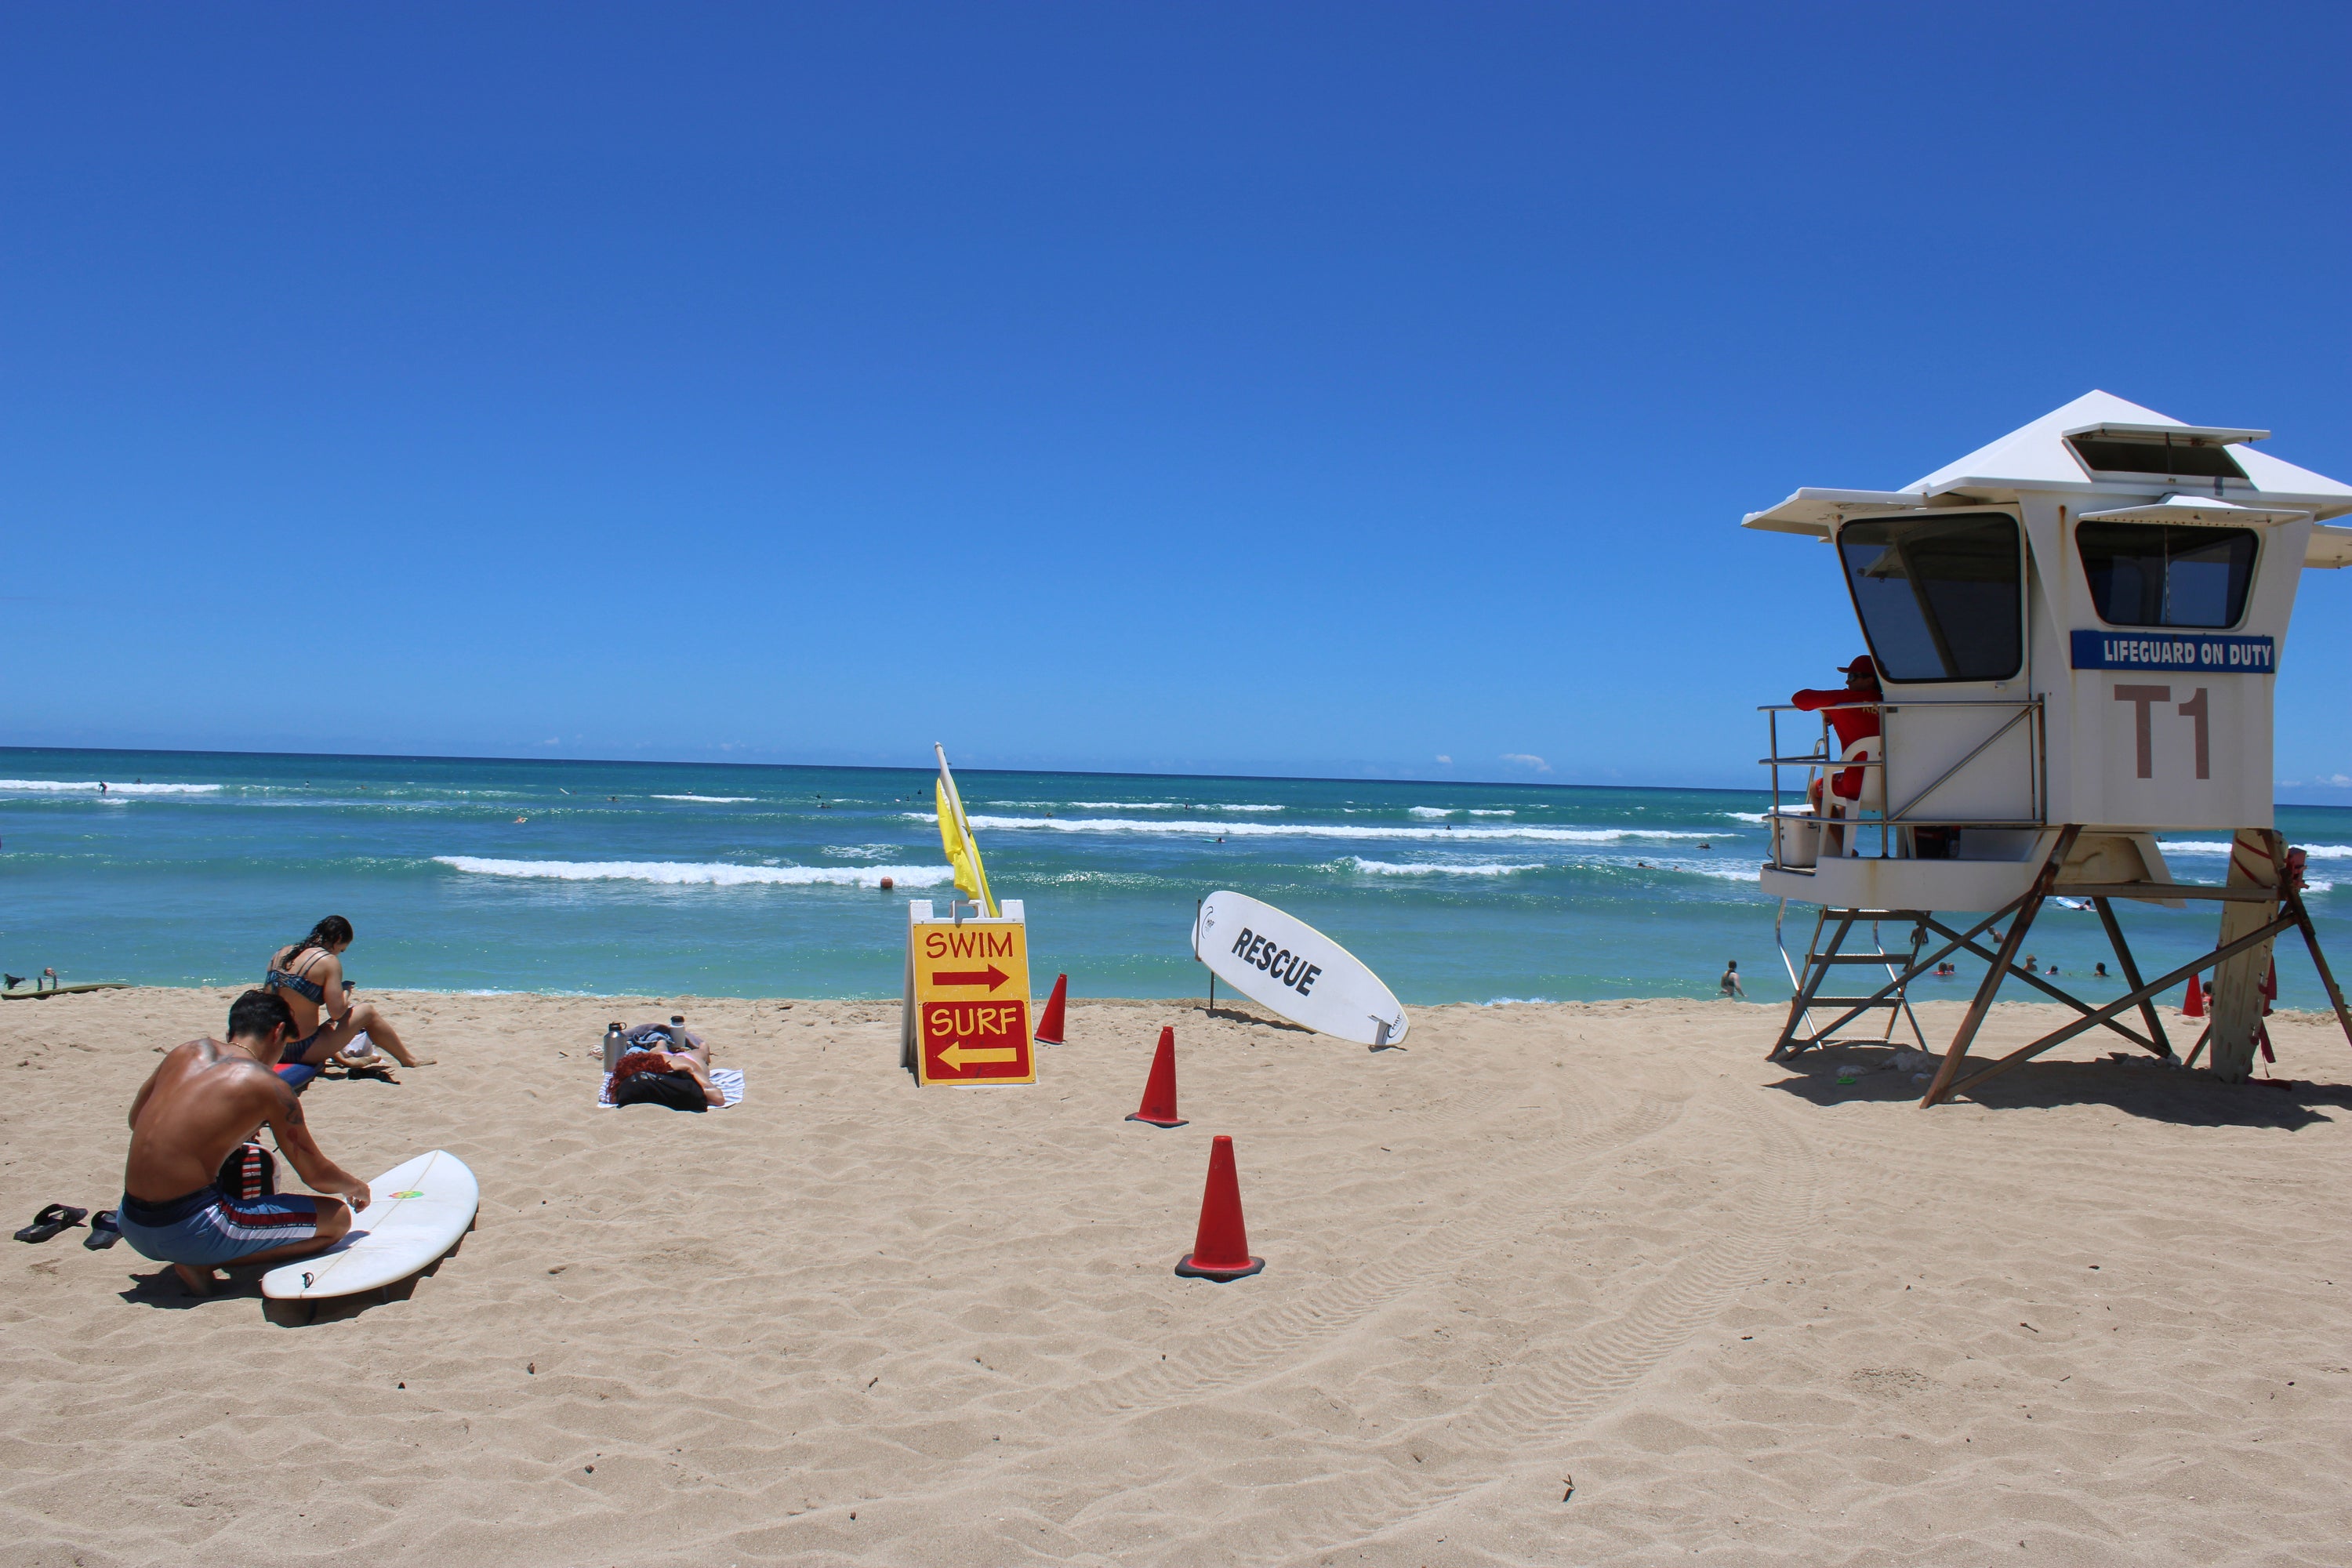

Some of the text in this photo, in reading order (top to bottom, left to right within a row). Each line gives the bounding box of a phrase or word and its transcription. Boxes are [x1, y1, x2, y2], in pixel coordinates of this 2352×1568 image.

[2103, 640, 2272, 666] LIFEGUARD ON DUTY
[2114, 684, 2210, 780] T1
[925, 931, 1014, 959] SWIM
[1231, 927, 1323, 997] RESCUE
[931, 1007, 1017, 1036] SURF
